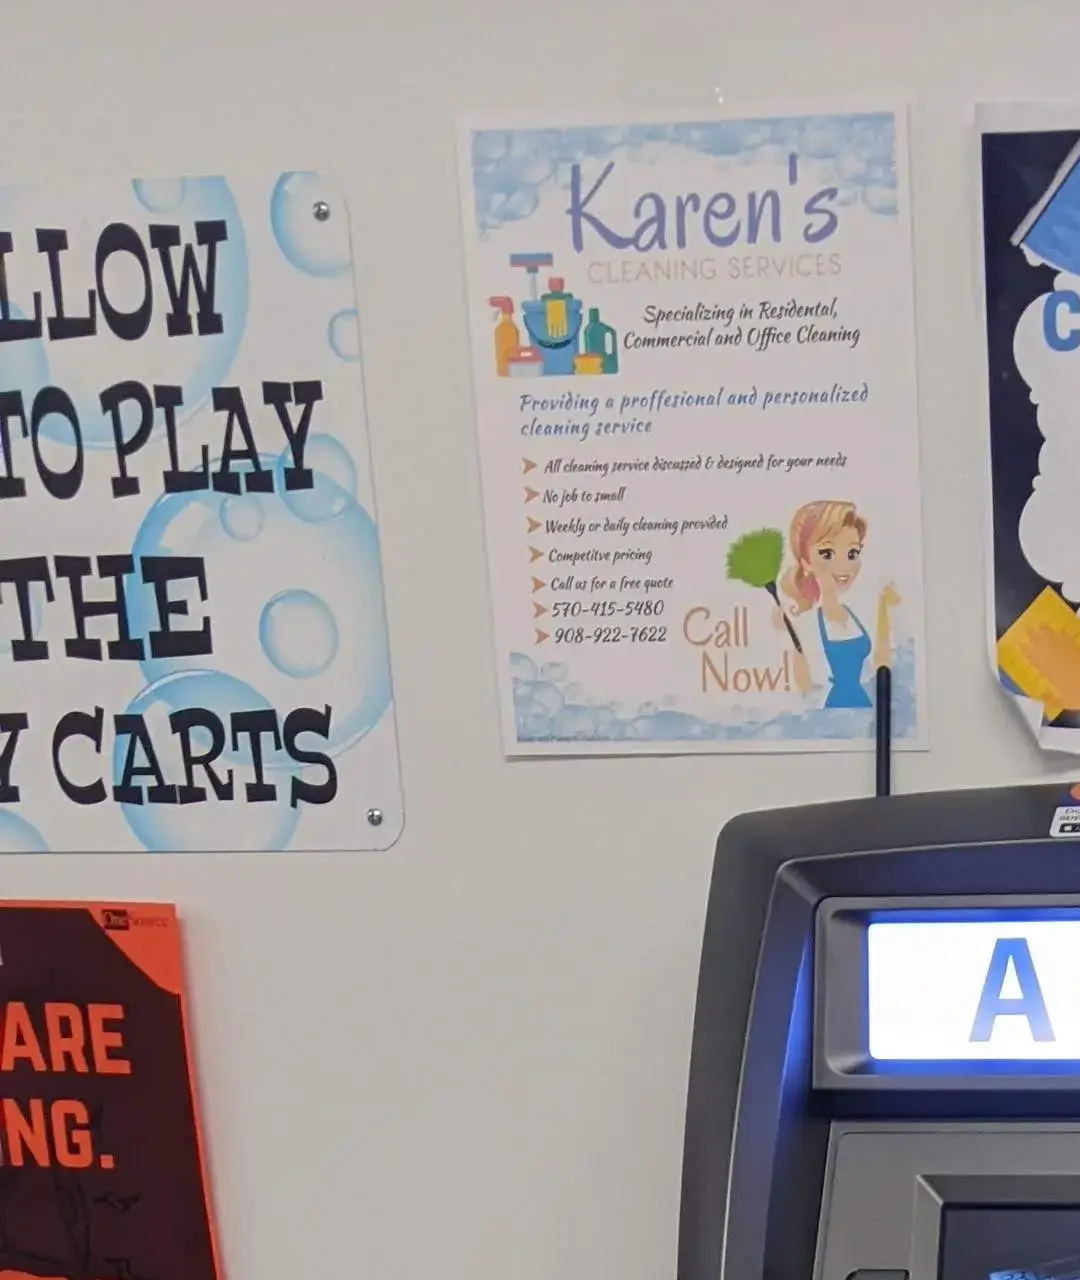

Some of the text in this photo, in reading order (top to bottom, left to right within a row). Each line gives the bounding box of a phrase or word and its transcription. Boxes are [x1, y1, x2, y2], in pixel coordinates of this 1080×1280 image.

[566, 153, 838, 252] Karen's
[588, 253, 842, 284] CLEANING SERVICES
[643, 302, 734, 328] Specializing
[739, 306, 753, 318] in
[624, 324, 861, 351] Commercial and Office Cleaning
[520, 392, 598, 416] Providing
[605, 397, 613, 408] a
[727, 386, 757, 406] and
[762, 382, 868, 410] personalized
[100, 379, 323, 499] PLAY
[520, 418, 653, 441] cleaning service
[544, 458, 560, 473] All
[563, 459, 609, 478] cleaning
[612, 460, 650, 476] service
[653, 456, 702, 471] discussed
[717, 454, 764, 473] designed
[767, 454, 783, 470] for
[787, 457, 814, 472] your
[816, 452, 847, 466] needs
[543, 486, 626, 507] No job to small
[546, 514, 728, 537] Weekly or daily cleaning provided
[613, 549, 653, 565] pricing
[551, 575, 674, 593] Call us for a free quote
[0, 554, 213, 662] THE
[552, 600, 664, 617] 570-415-5480
[555, 626, 667, 643] 908-922-7622
[683, 607, 748, 649] Call
[702, 652, 790, 694] Now!
[52, 704, 337, 809] CARTS
[1, 1002, 131, 1074] ARE
